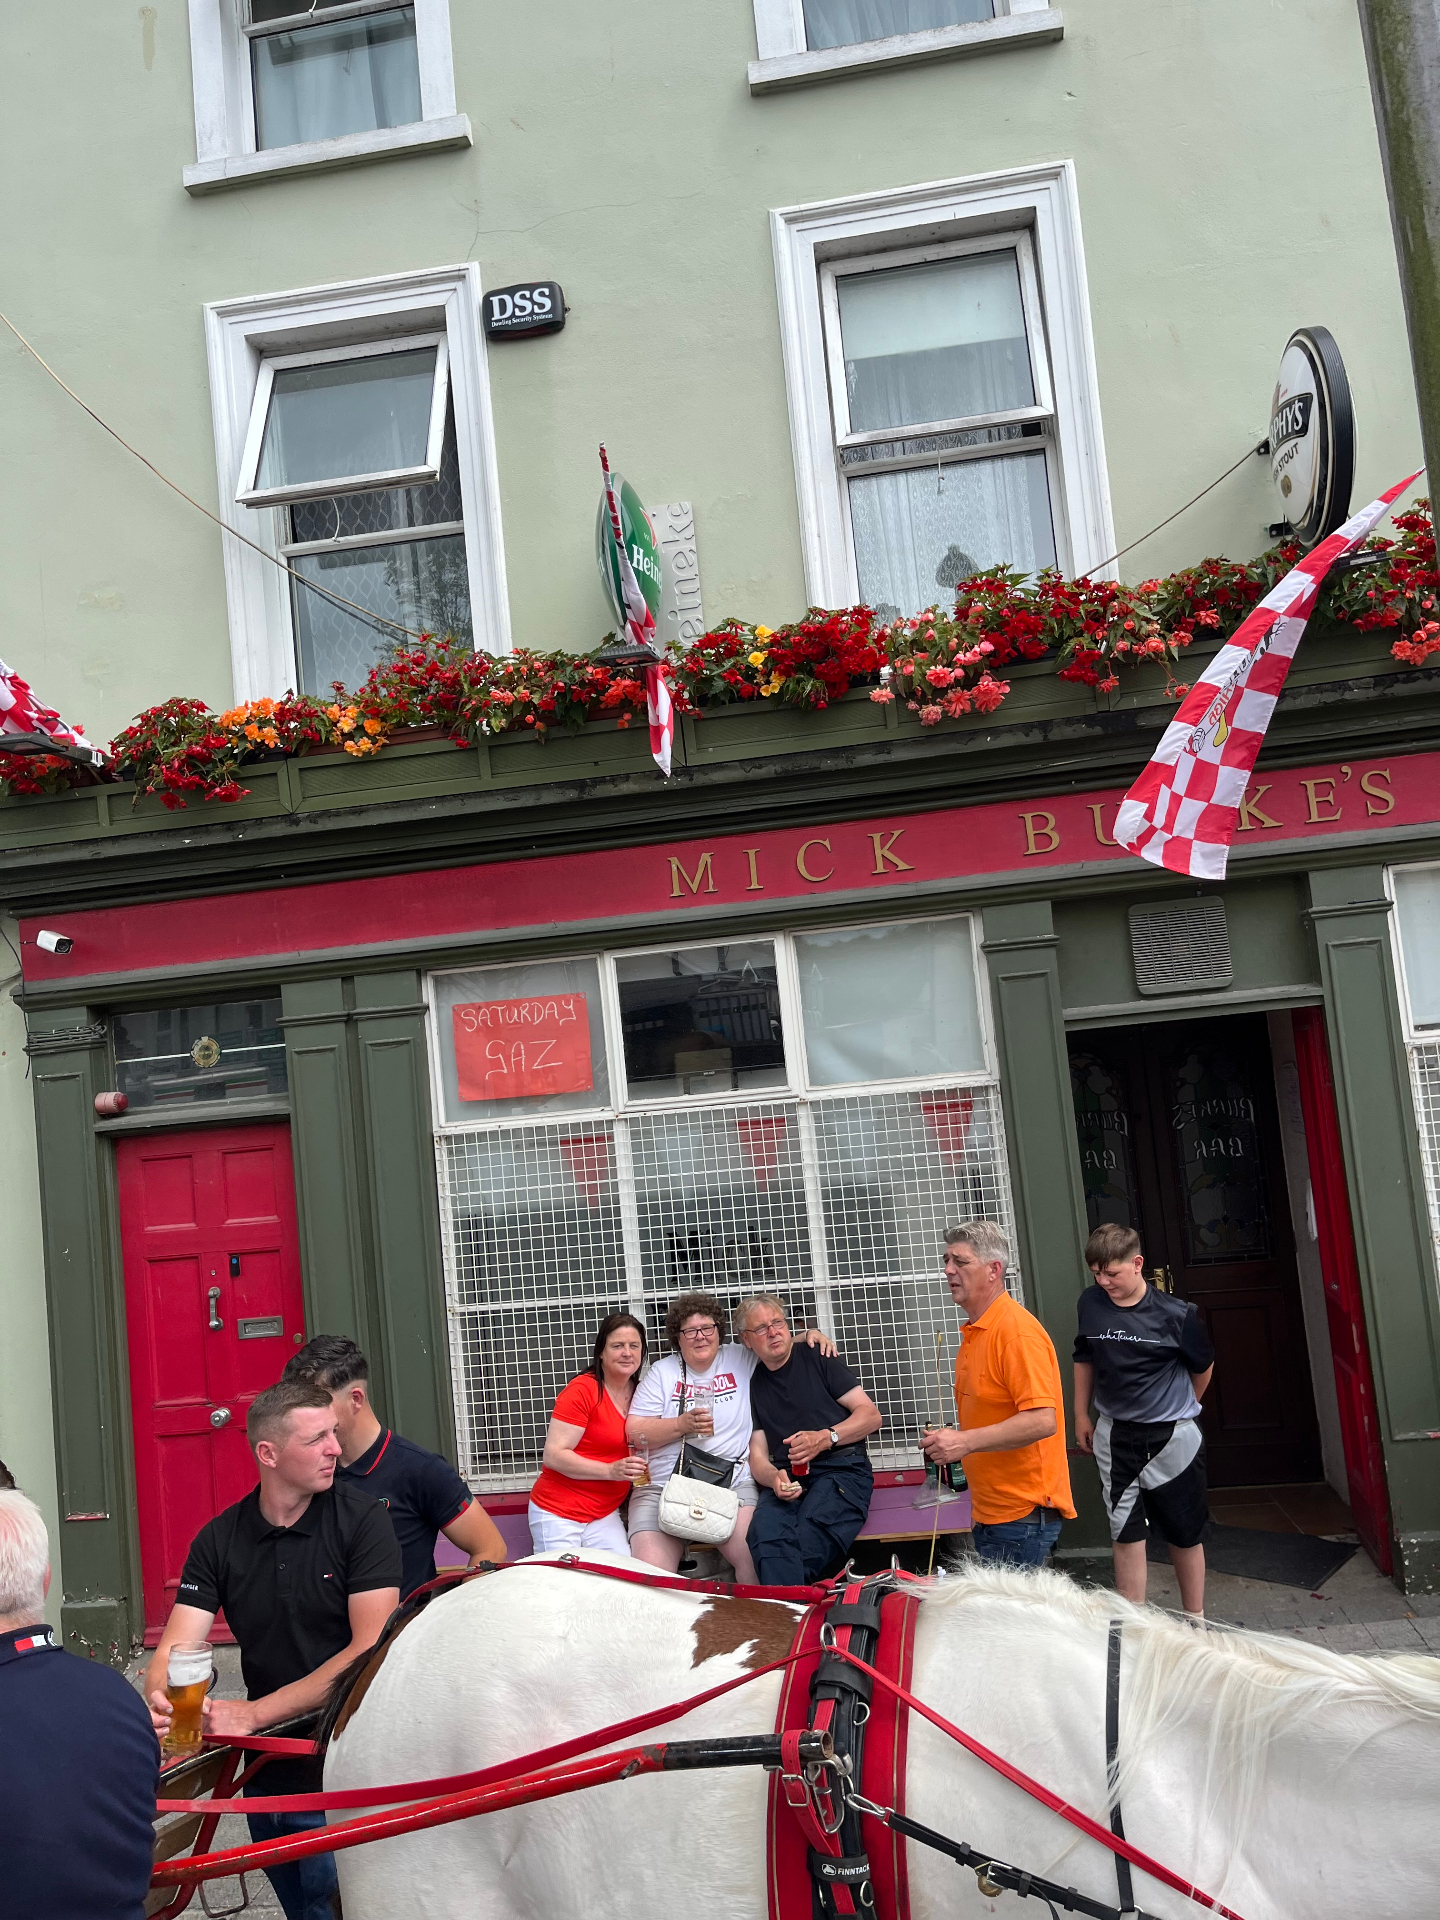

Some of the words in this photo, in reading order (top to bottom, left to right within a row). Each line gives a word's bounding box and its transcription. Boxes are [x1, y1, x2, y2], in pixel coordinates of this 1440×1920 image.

[489, 287, 552, 321] DSS
[512, 316, 532, 325] Security
[532, 313, 553, 321] Systems
[1278, 442, 1299, 472] STOUT
[667, 829, 915, 898] MICK
[1018, 765, 1396, 855] BUKE'S
[461, 998, 577, 1032] SATURDAY
[715, 1396, 734, 1404] CLUB
